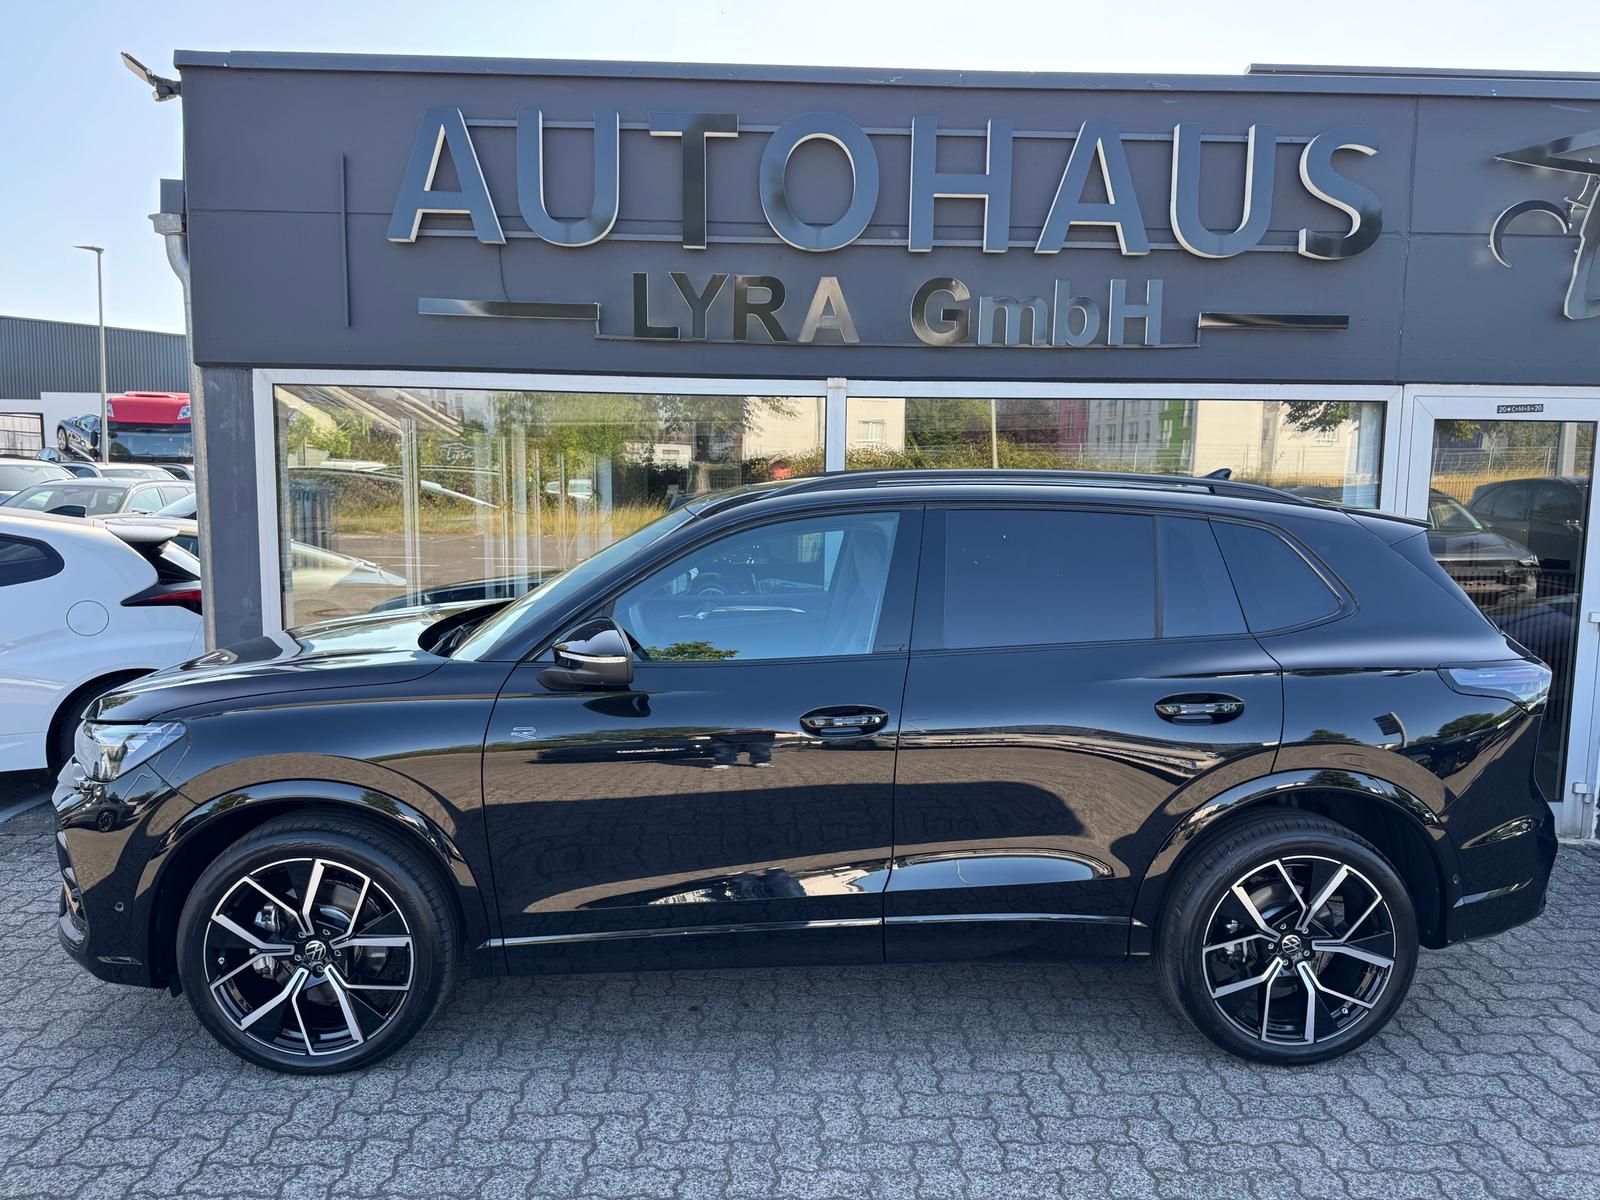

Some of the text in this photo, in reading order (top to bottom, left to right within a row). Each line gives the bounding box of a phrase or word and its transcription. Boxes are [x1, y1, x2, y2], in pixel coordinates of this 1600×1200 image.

[387, 107, 1383, 261] AUTOHAUS
[632, 271, 1165, 346] LYRA GmbH
